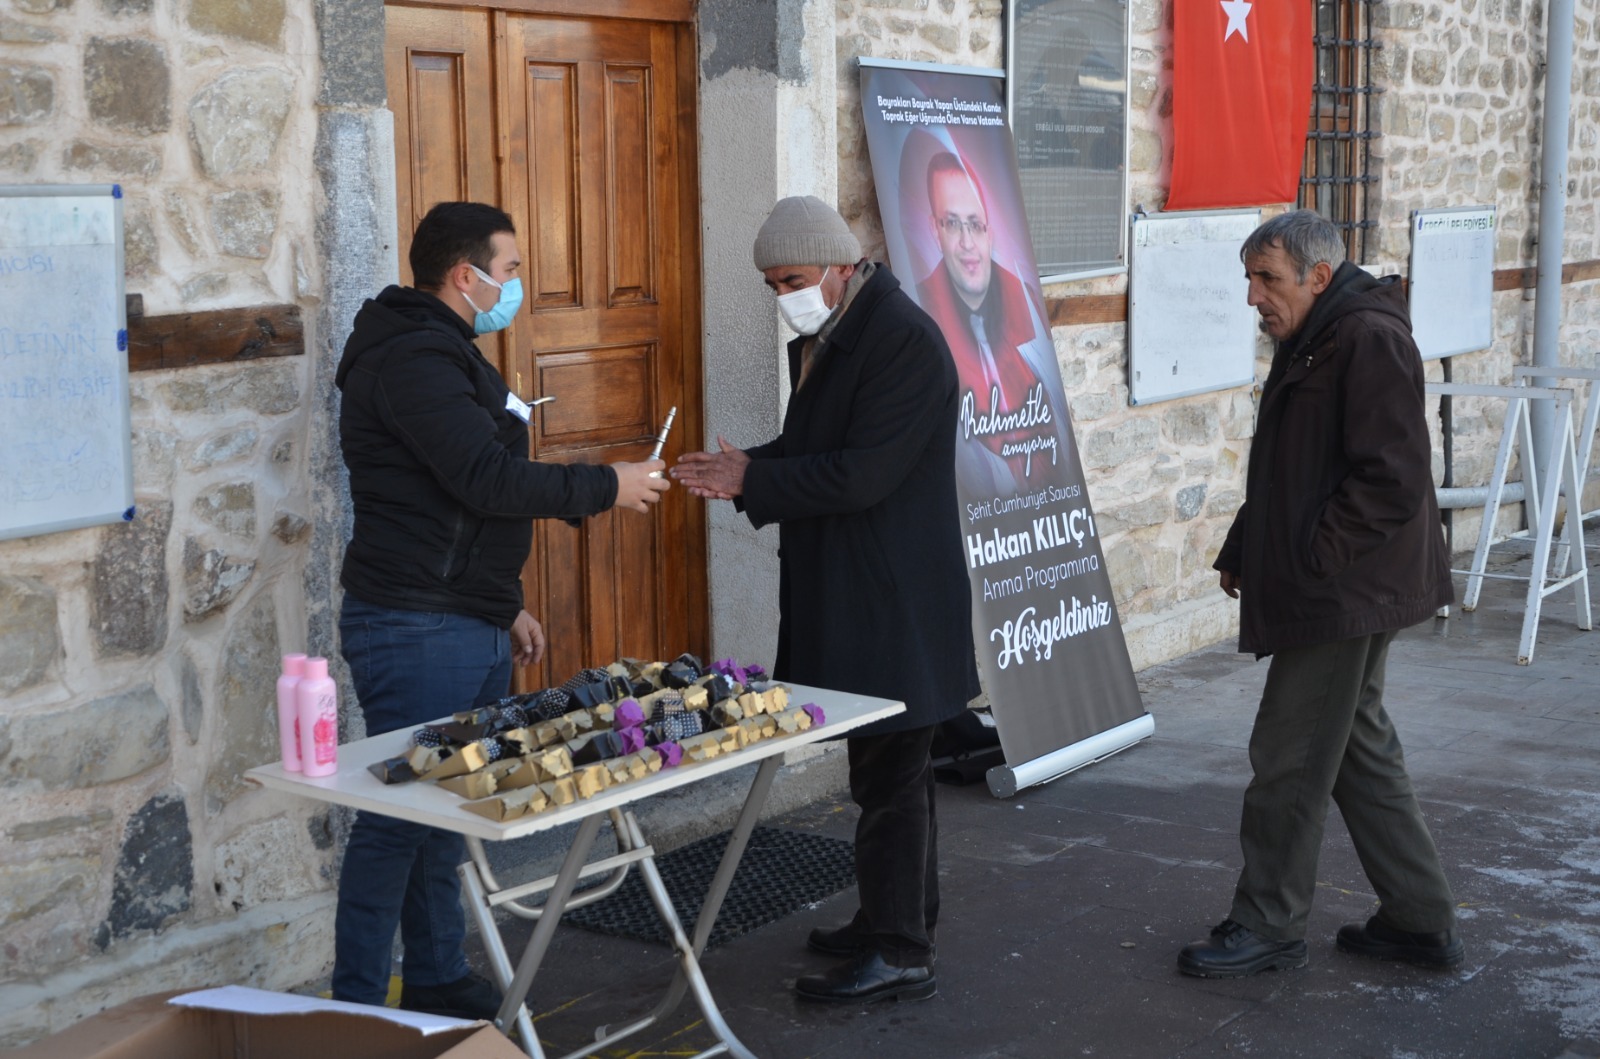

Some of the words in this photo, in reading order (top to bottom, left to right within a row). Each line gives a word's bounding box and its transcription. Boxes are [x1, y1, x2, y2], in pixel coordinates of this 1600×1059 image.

[881, 110, 904, 124] Toprak
[904, 111, 919, 125] Eğer
[919, 112, 946, 126] Uğrunda
[946, 110, 961, 124] Ölen
[960, 113, 978, 125] Varsa
[911, 97, 934, 111] Bayrak
[934, 98, 953, 112] Yapan
[953, 97, 982, 112] Üstündeki
[960, 382, 1052, 440] Rahmetle
[967, 503, 992, 525] Şehit
[993, 488, 1049, 515] Cumhuriyet
[1048, 484, 1082, 502] Savcısı
[967, 527, 1032, 568] Hakan
[1033, 507, 1095, 548] KILIÇ'ı
[983, 575, 1024, 602] Anma
[1024, 554, 1099, 589] Programına
[990, 594, 1112, 669] Hoşgeldiniz
